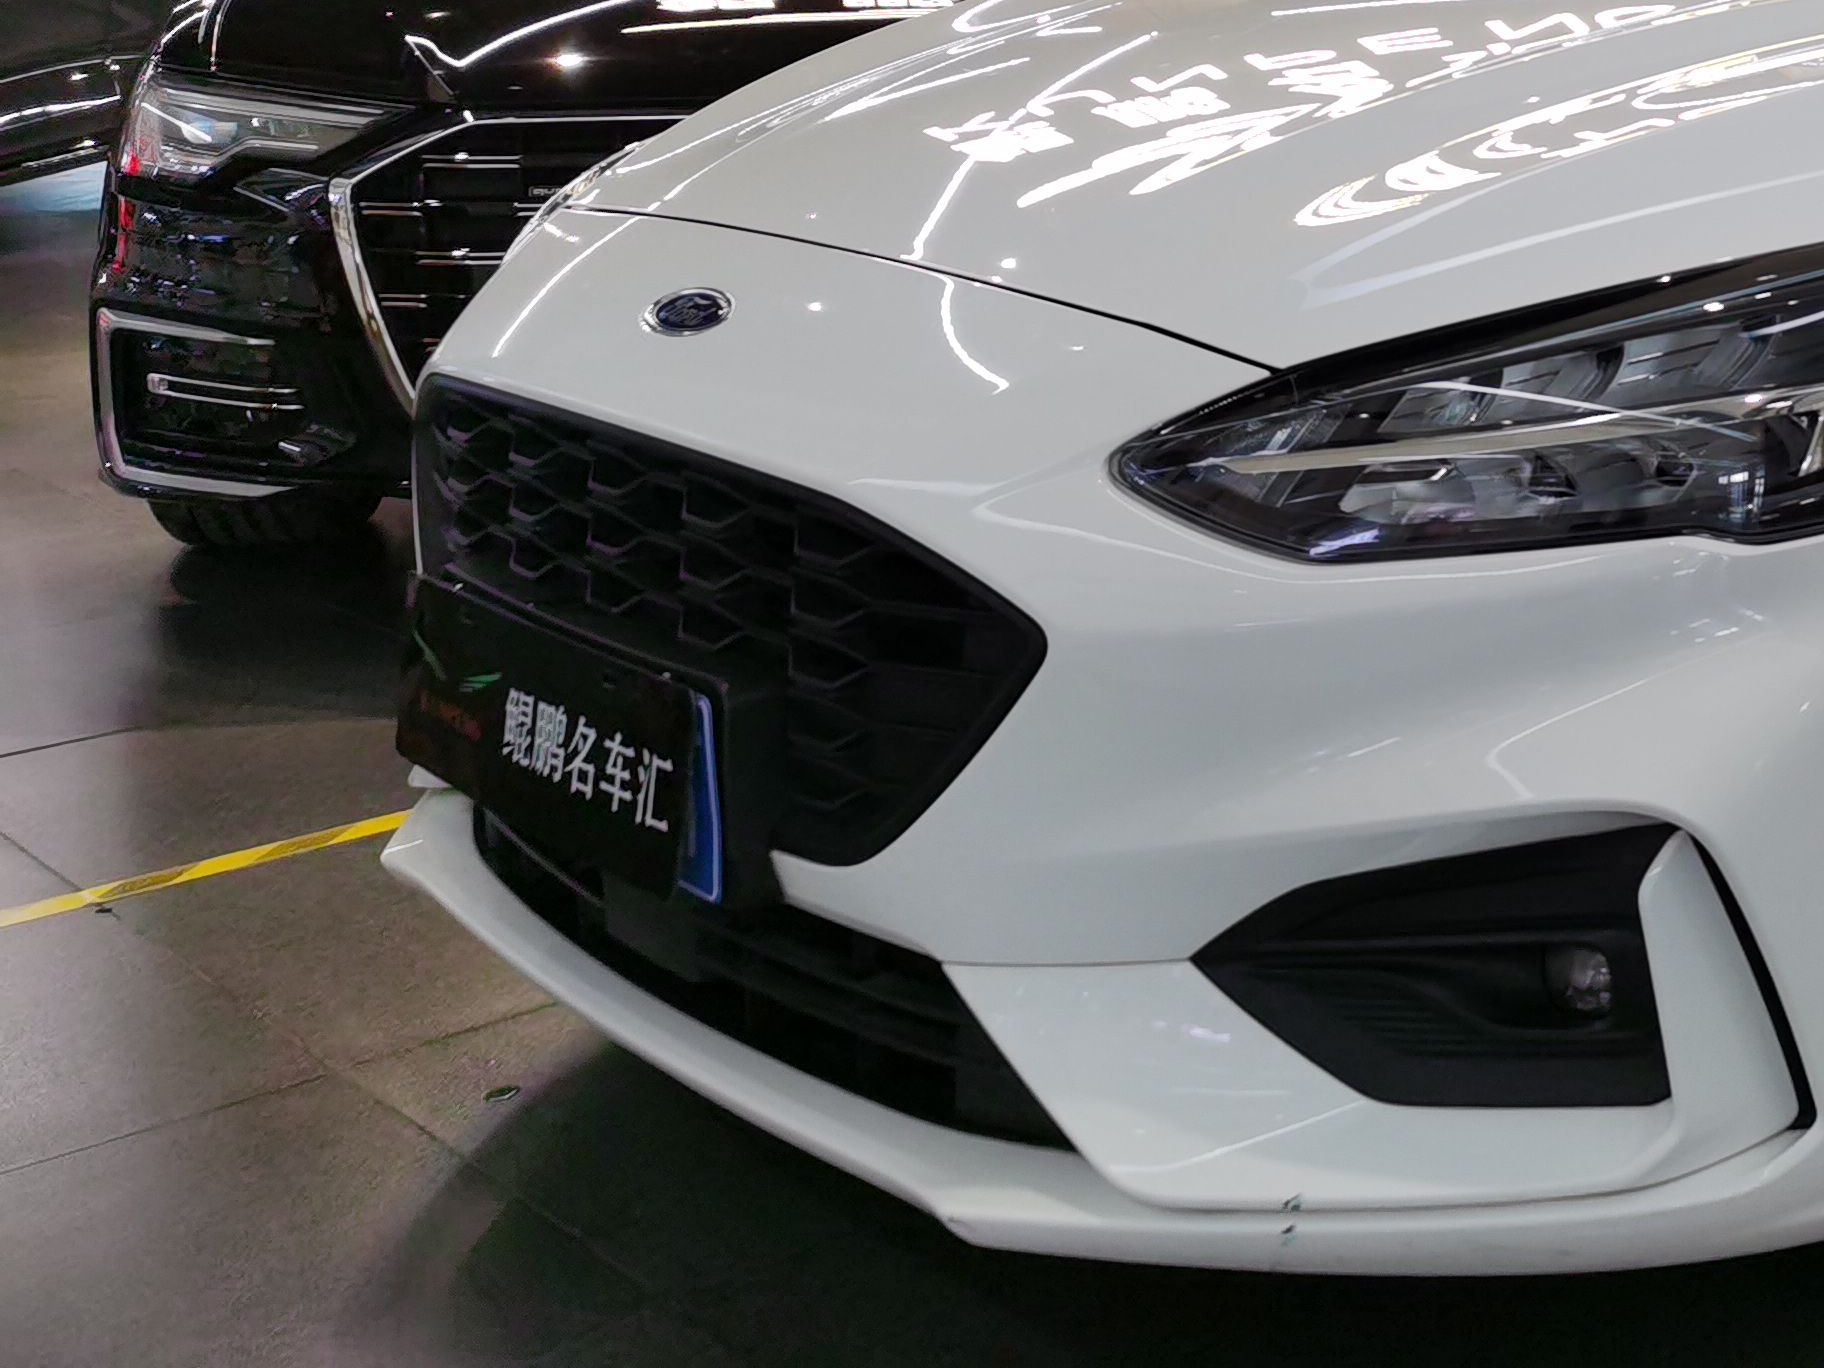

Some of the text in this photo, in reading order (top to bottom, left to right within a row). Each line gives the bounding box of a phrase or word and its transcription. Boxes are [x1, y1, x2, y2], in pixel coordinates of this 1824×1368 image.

[502, 687, 674, 832] 鲲鹏名车汇
